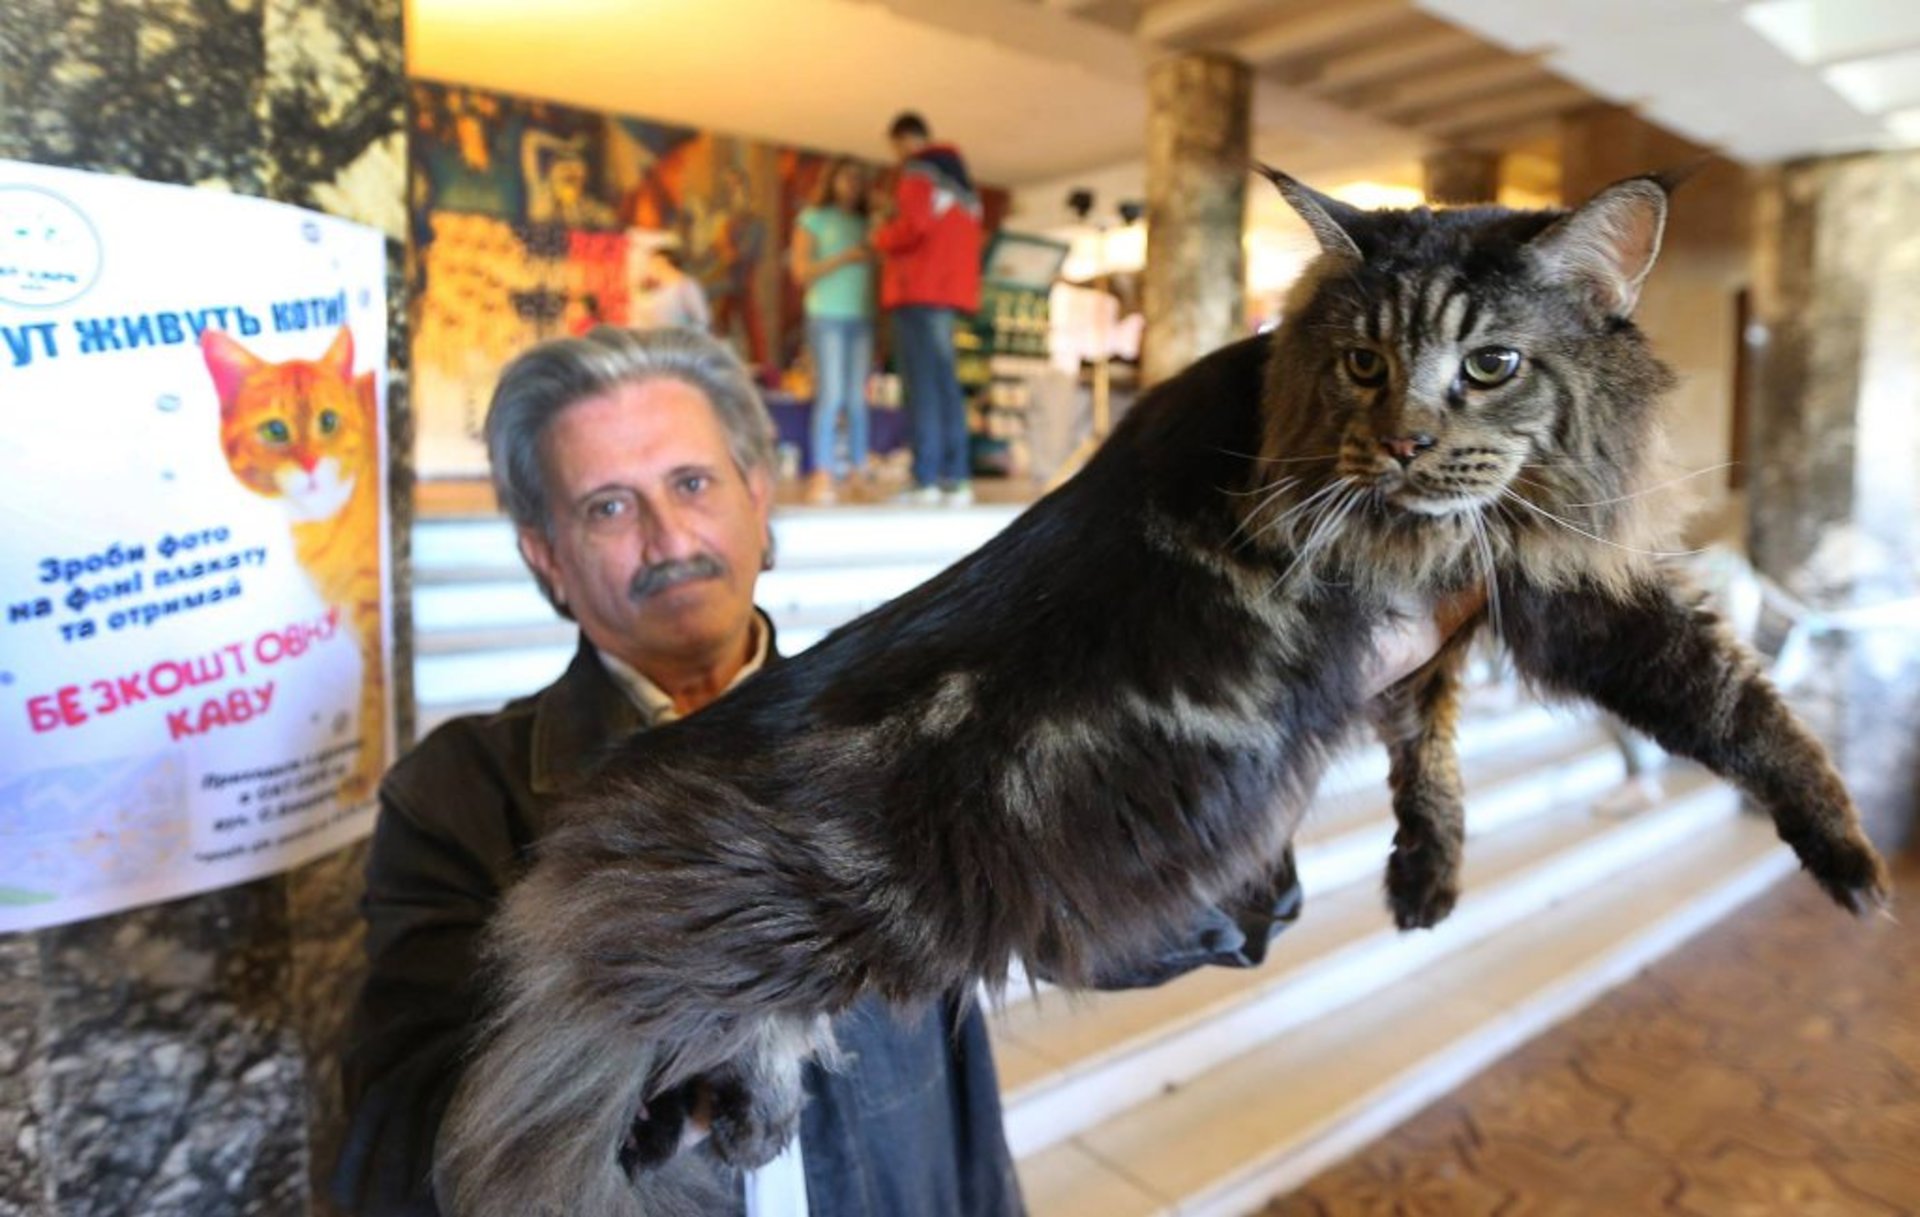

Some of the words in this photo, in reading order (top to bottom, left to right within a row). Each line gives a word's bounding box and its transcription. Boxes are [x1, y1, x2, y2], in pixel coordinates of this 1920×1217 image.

[75, 306, 261, 354] ЖИВУТЬ
[271, 288, 346, 332] КОТИ!
[9, 597, 53, 624] на
[67, 573, 143, 613] фоні
[154, 547, 267, 587] плакату
[39, 543, 146, 584] Зроби
[158, 526, 230, 560] фото
[60, 621, 96, 642] та
[108, 580, 242, 631] отримай
[166, 681, 275, 741] КАВУ
